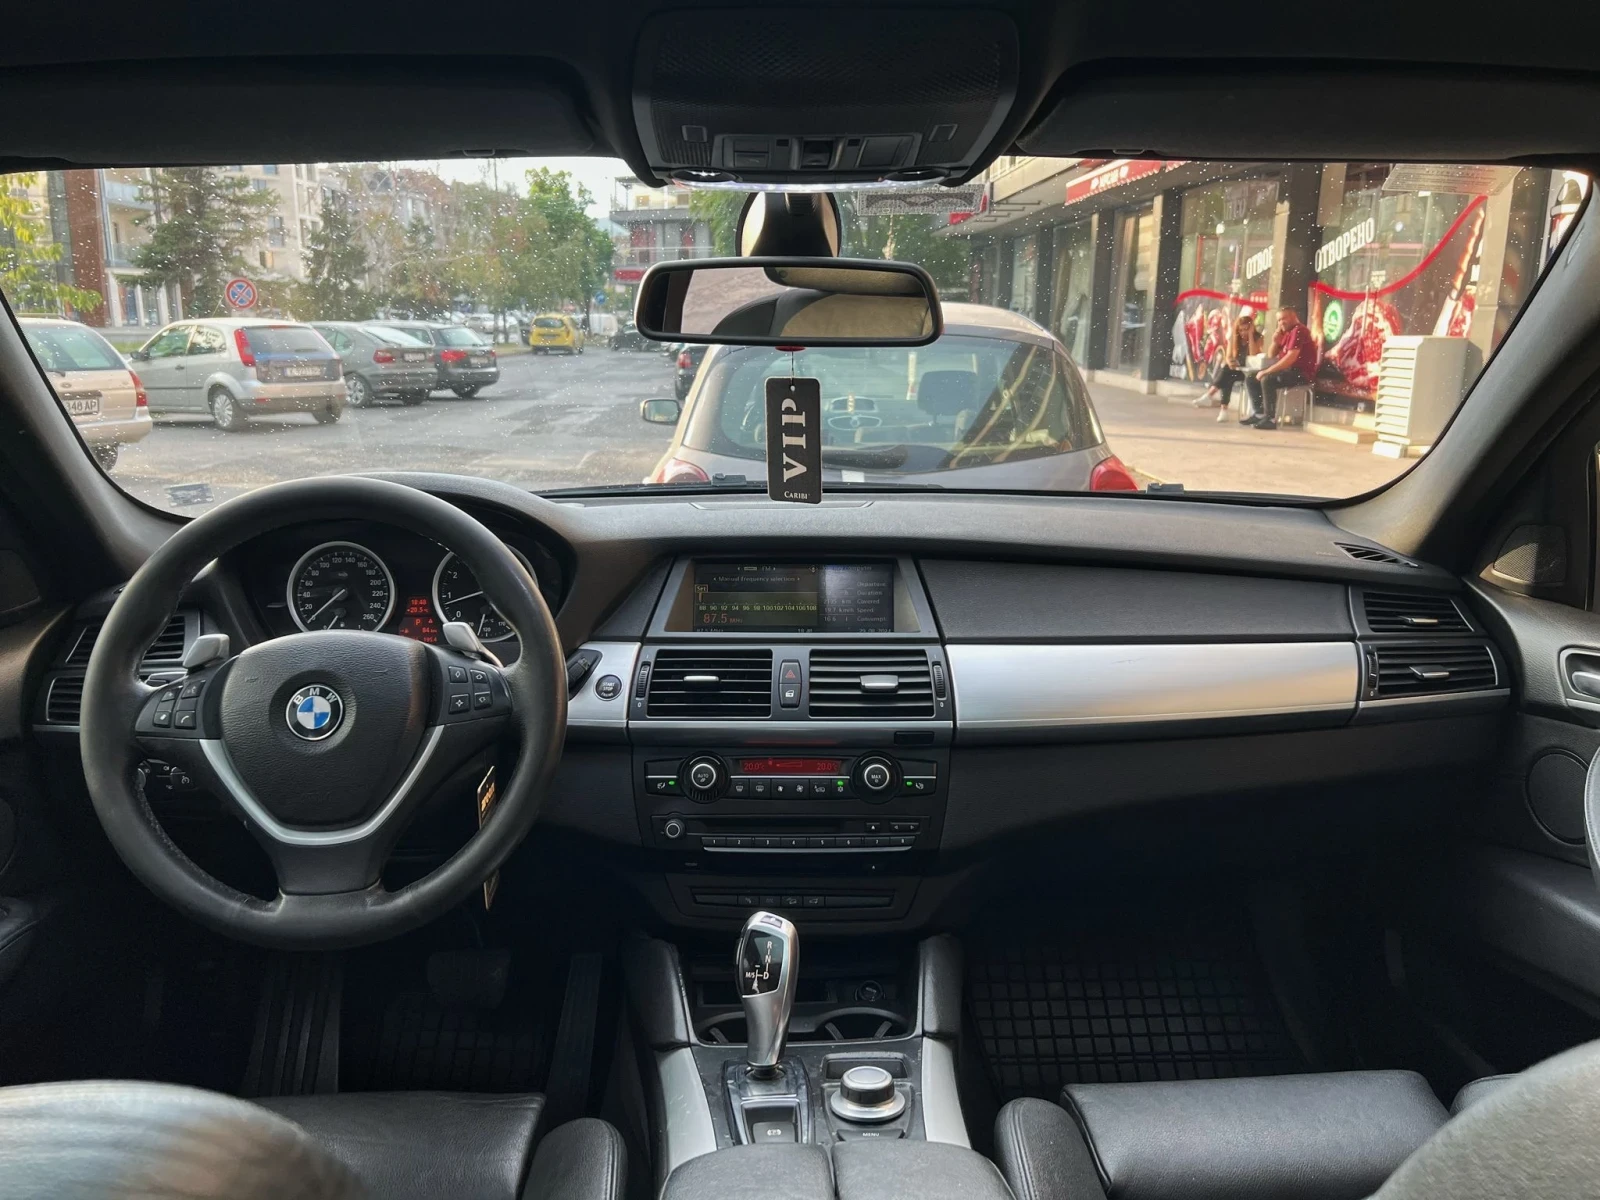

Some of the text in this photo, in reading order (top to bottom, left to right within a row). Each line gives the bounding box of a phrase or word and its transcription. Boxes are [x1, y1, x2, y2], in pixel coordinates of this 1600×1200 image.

[1315, 218, 1375, 273] ОТВОРЕНО
[781, 398, 807, 483] VIP
[452, 571, 458, 579] 2
[455, 610, 462, 618] 0
[703, 613, 728, 624] 87.5
[293, 687, 339, 704] BMW
[766, 941, 773, 949] R
[764, 955, 771, 963] N
[763, 972, 769, 980] D
